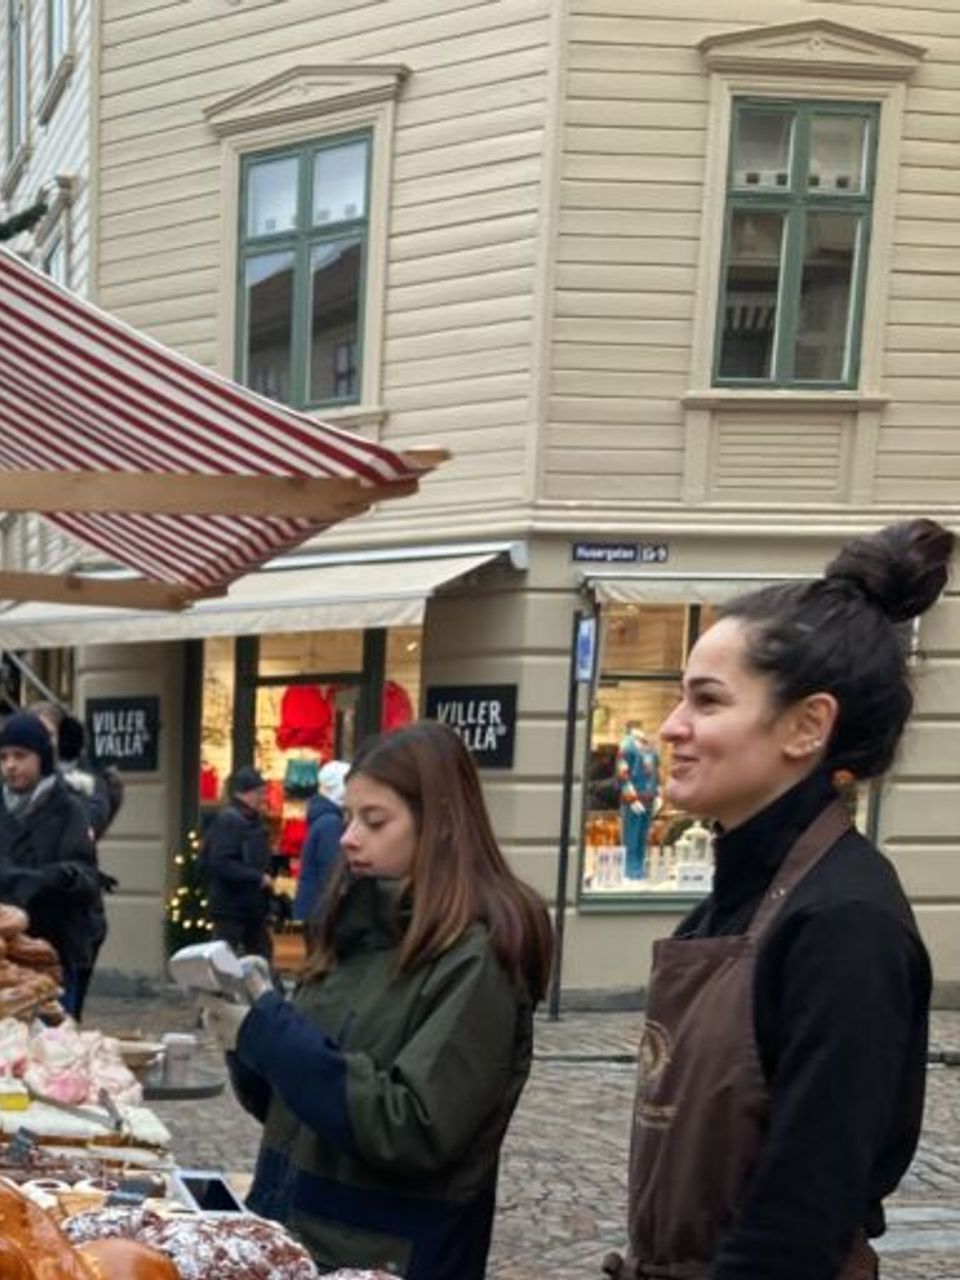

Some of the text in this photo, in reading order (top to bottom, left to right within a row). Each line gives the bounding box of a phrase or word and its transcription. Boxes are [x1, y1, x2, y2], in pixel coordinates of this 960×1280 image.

[93, 710, 145, 733] VILLER
[437, 701, 501, 725] VILLER
[95, 733, 144, 757] VALLA
